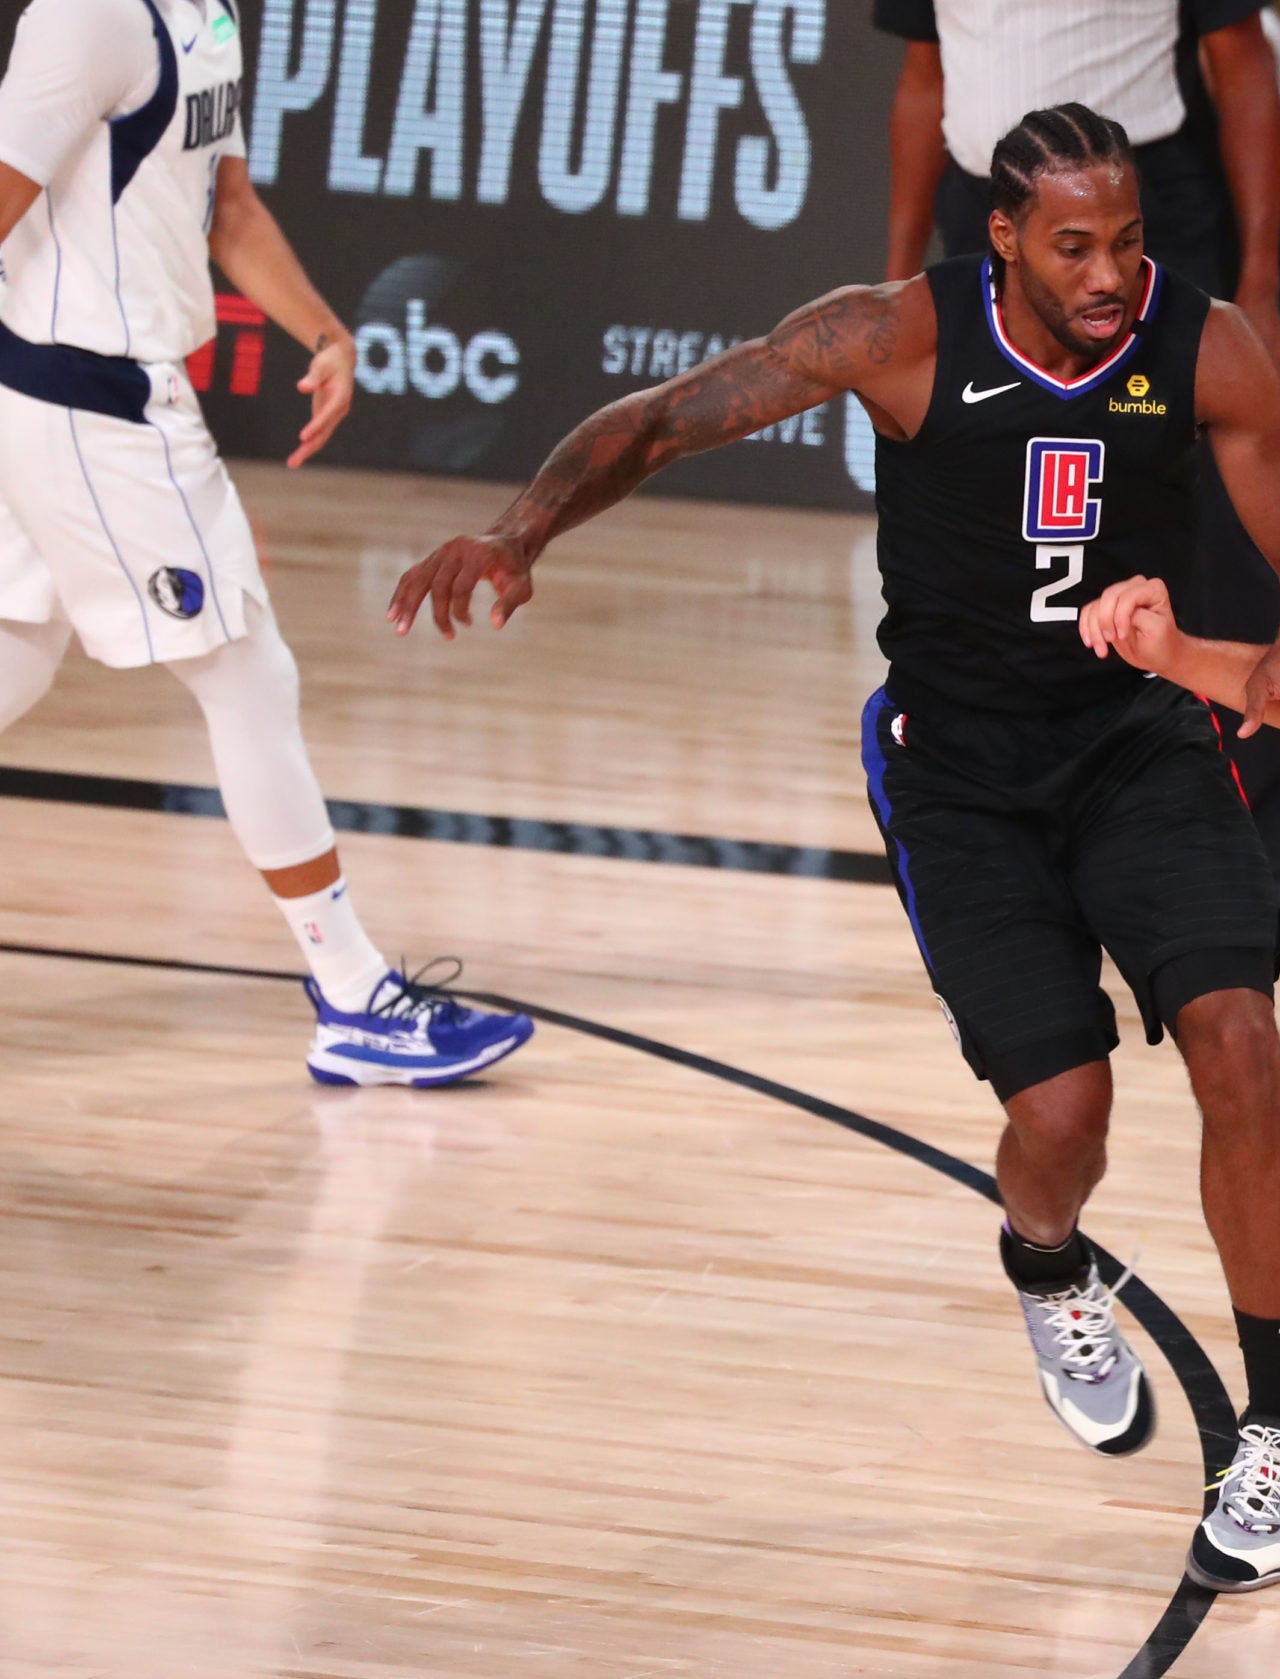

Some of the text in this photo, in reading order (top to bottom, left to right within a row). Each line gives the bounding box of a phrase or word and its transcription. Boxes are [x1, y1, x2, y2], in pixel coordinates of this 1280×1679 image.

[182, 75, 242, 151] DALLA
[246, 0, 827, 231] PLAYOFFS
[353, 299, 521, 404] abc
[602, 324, 745, 377] STRE
[1108, 397, 1167, 415] bumble
[1030, 545, 1085, 622] 2
